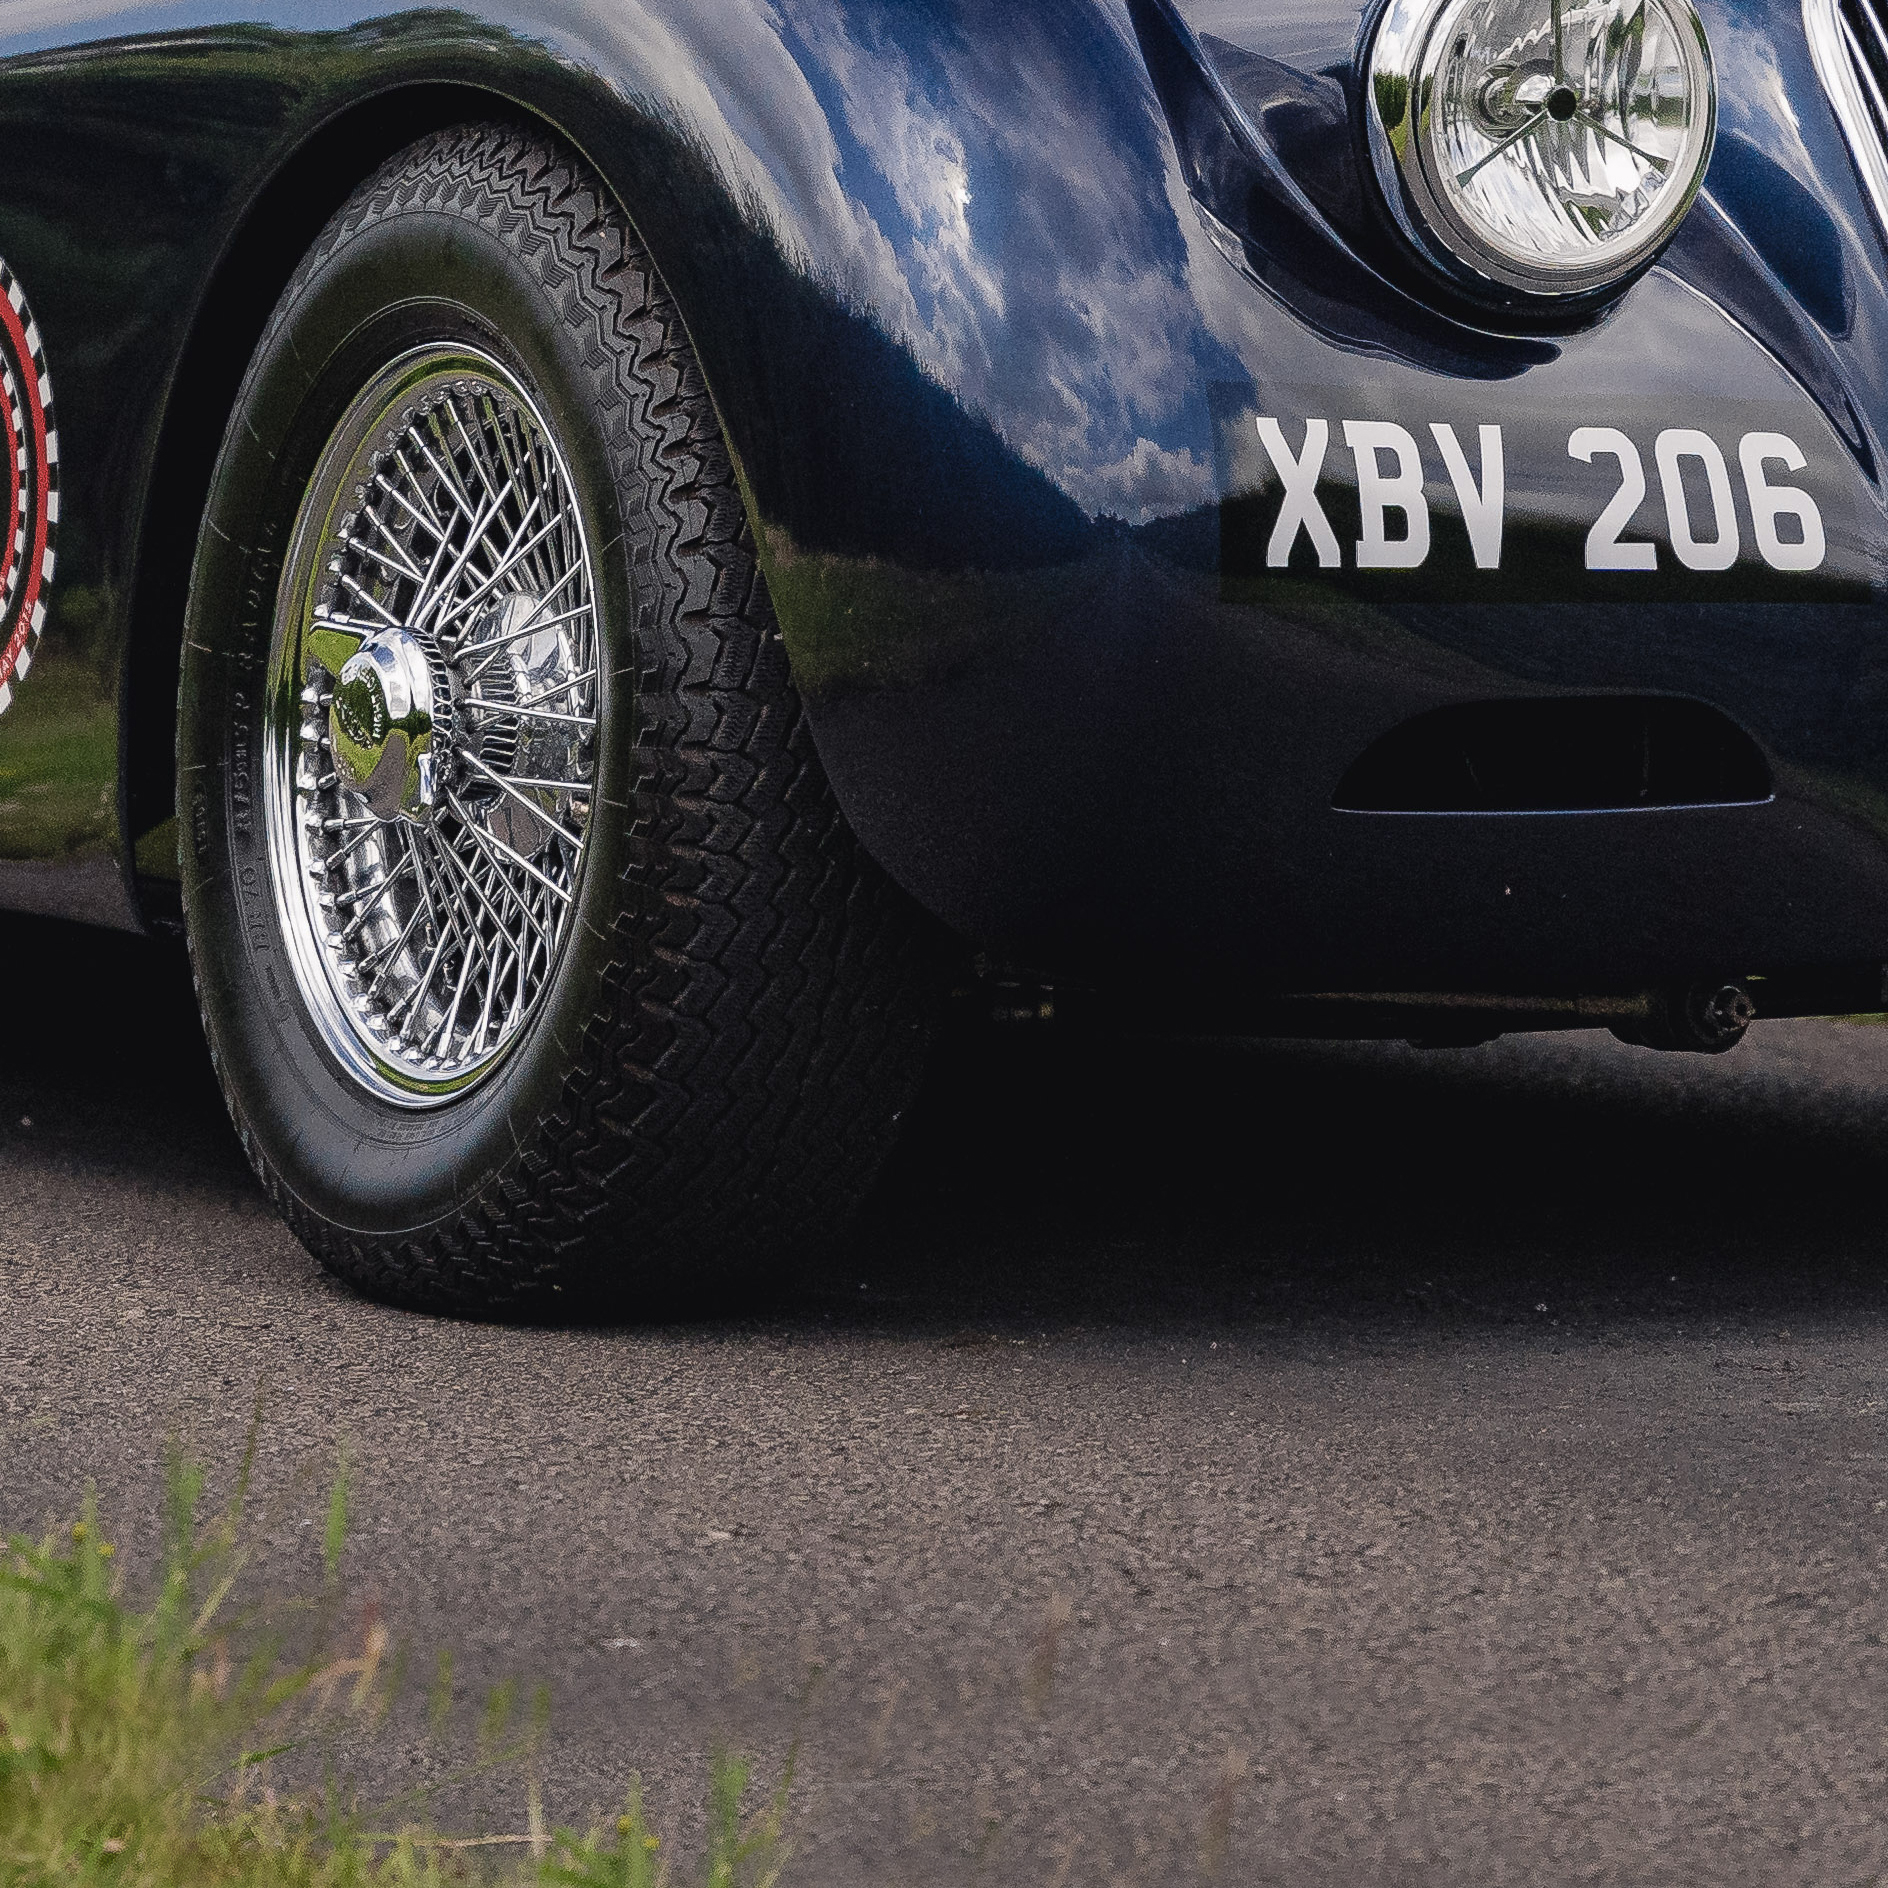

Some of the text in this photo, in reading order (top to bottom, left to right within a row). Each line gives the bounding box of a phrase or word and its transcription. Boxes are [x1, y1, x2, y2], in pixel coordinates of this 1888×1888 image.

[1255, 416, 1826, 570] XBV 206
[14, 598, 31, 649] 2015
